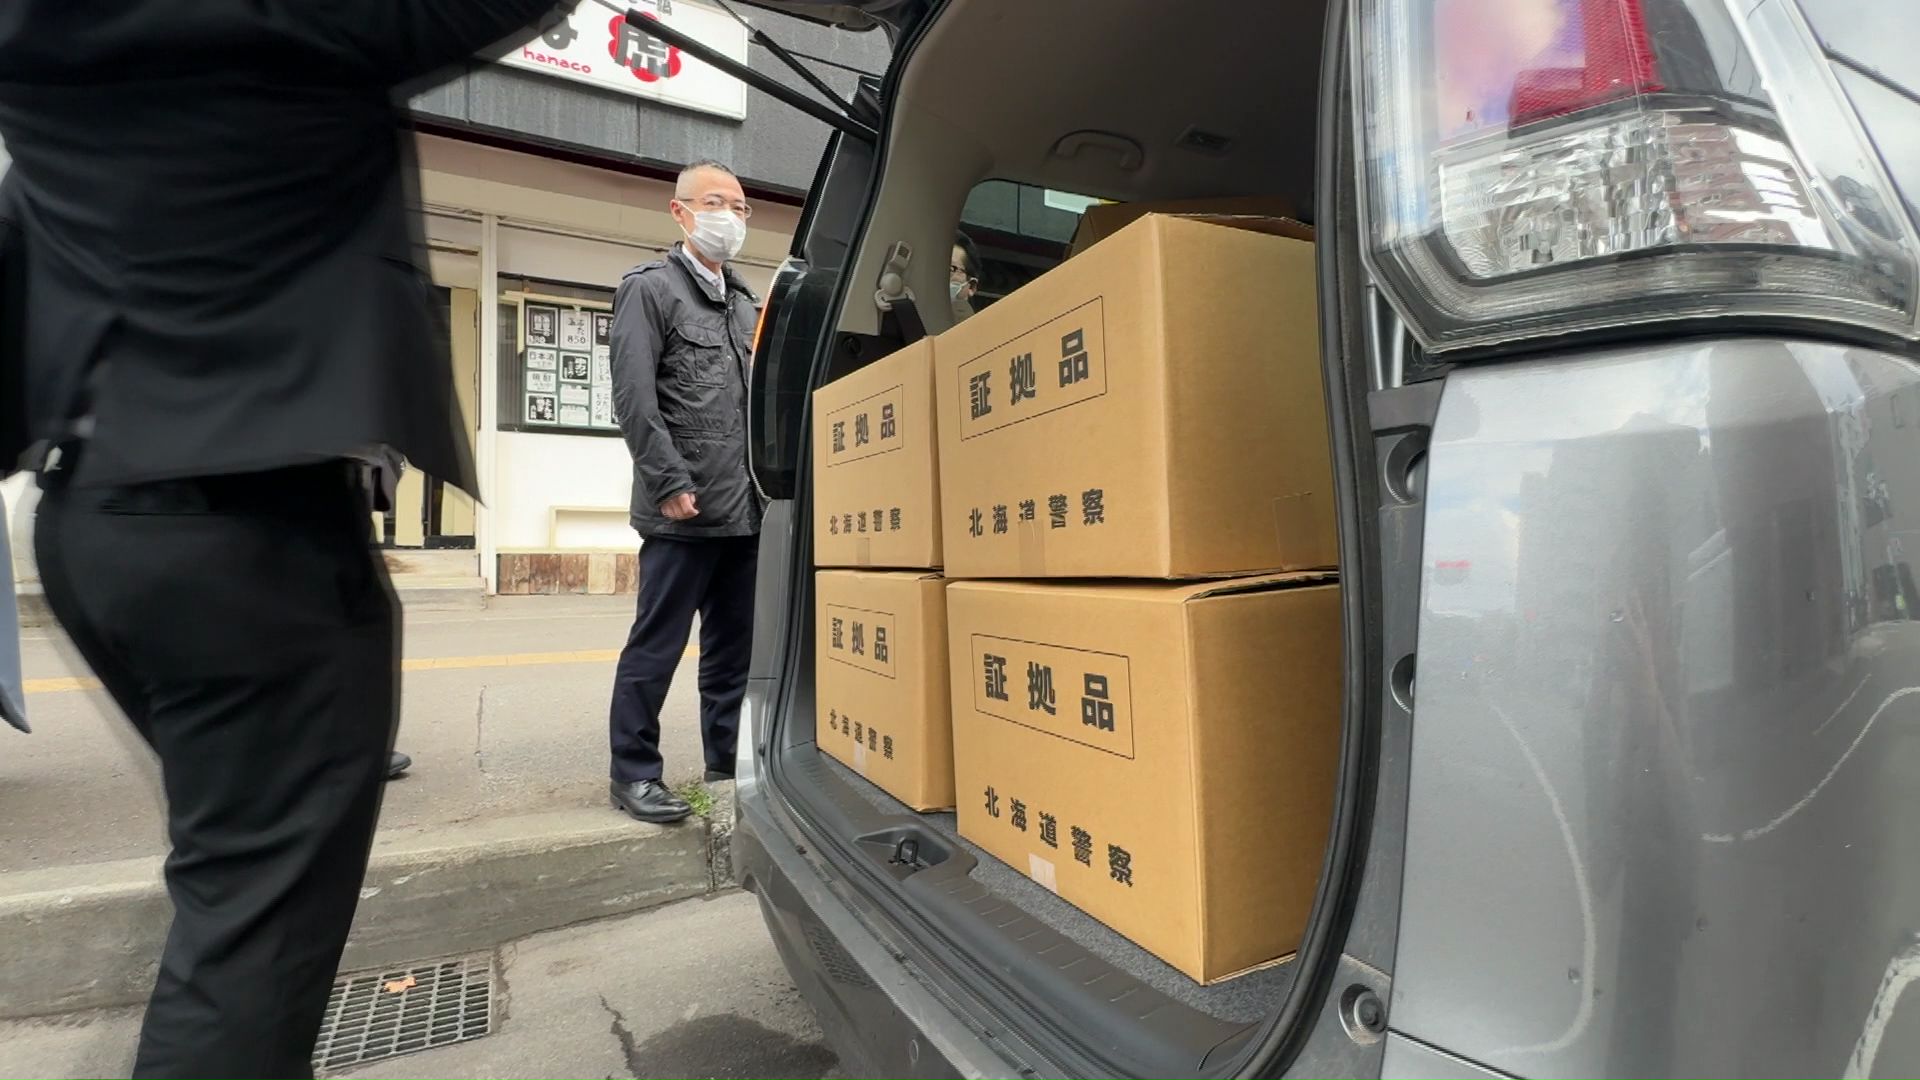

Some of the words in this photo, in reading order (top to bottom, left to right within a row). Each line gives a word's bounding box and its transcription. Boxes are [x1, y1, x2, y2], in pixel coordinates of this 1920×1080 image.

[523, 47, 592, 74] hanaco
[969, 328, 1090, 421] 証拠品
[833, 403, 896, 454] 証拠品
[829, 507, 901, 536] 北海道警察
[968, 488, 1105, 538] 北海道警察
[832, 617, 888, 664] 証拠品
[983, 653, 1116, 732] 証拠品
[984, 785, 1134, 888] 北海道警察
